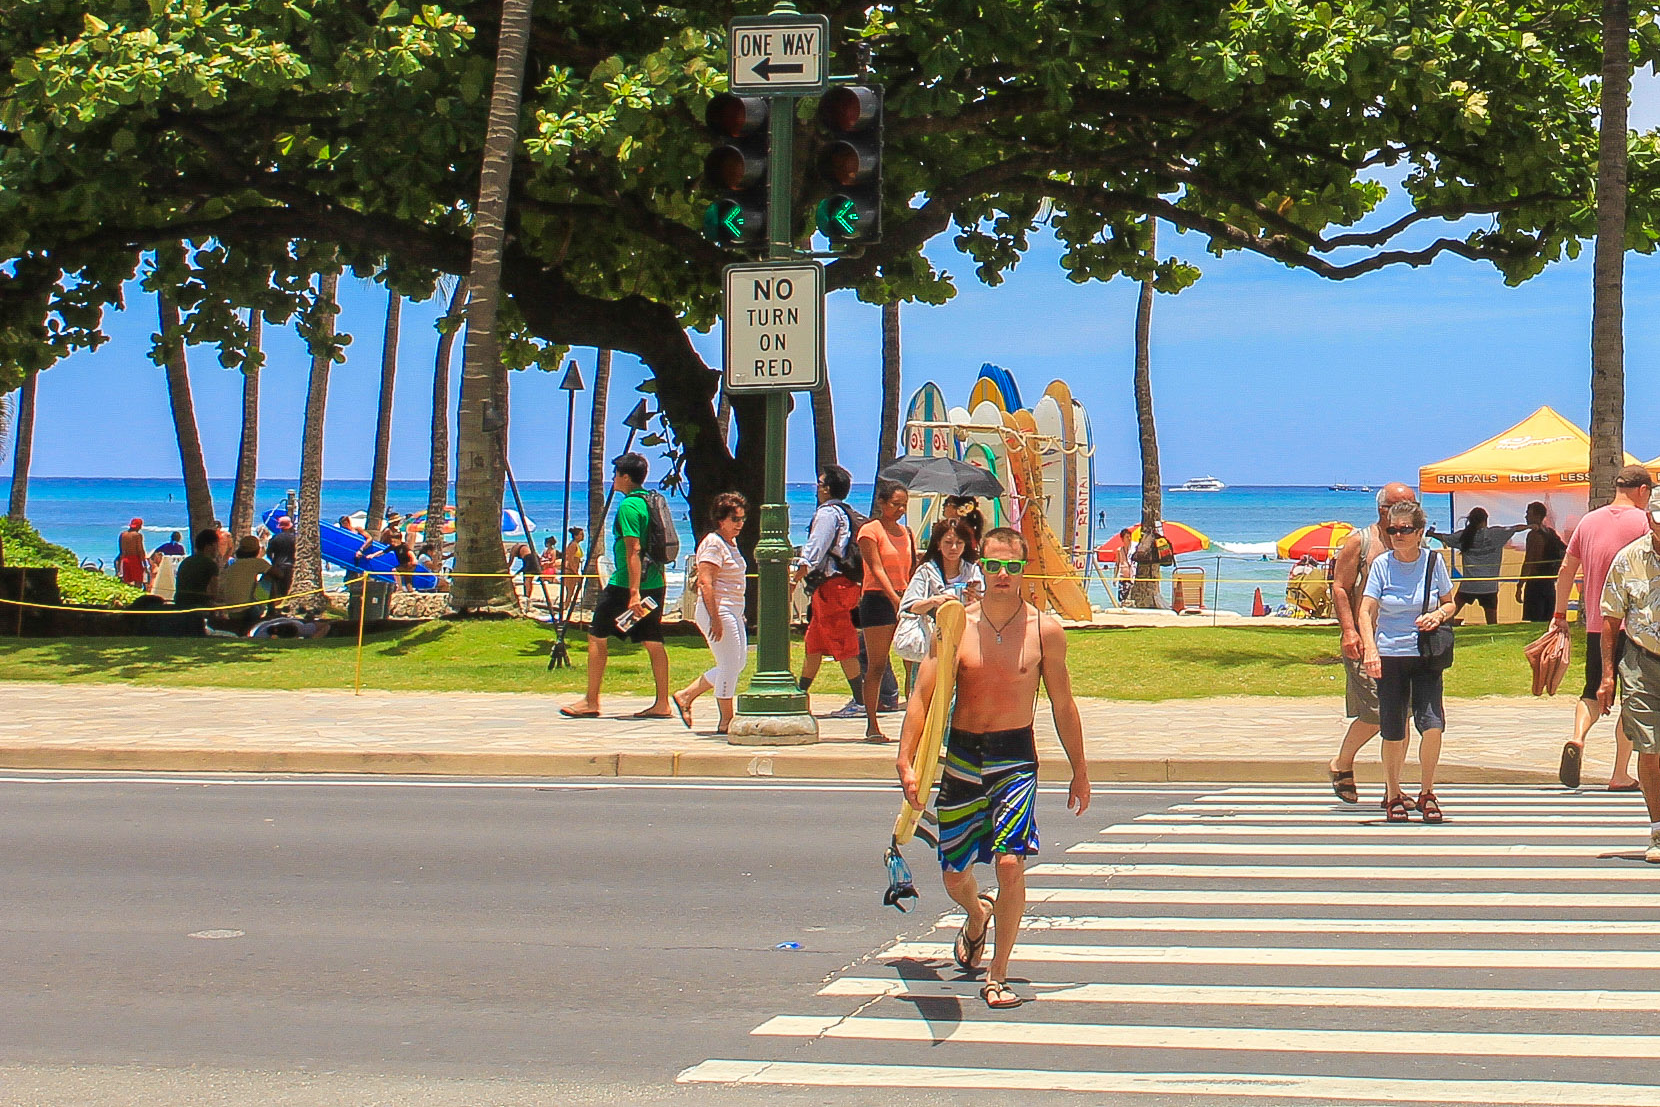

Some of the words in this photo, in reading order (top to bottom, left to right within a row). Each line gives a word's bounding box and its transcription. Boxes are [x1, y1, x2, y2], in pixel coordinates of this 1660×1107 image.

[740, 34, 773, 57] ONE
[782, 33, 815, 56] WAY
[754, 278, 794, 301] NO
[747, 308, 799, 326] TURN
[760, 334, 786, 351] ON
[754, 359, 793, 377] RED
[1437, 473, 1498, 484] RENTALS
[1509, 472, 1549, 483] RIDES
[1560, 472, 1590, 482] LESS
